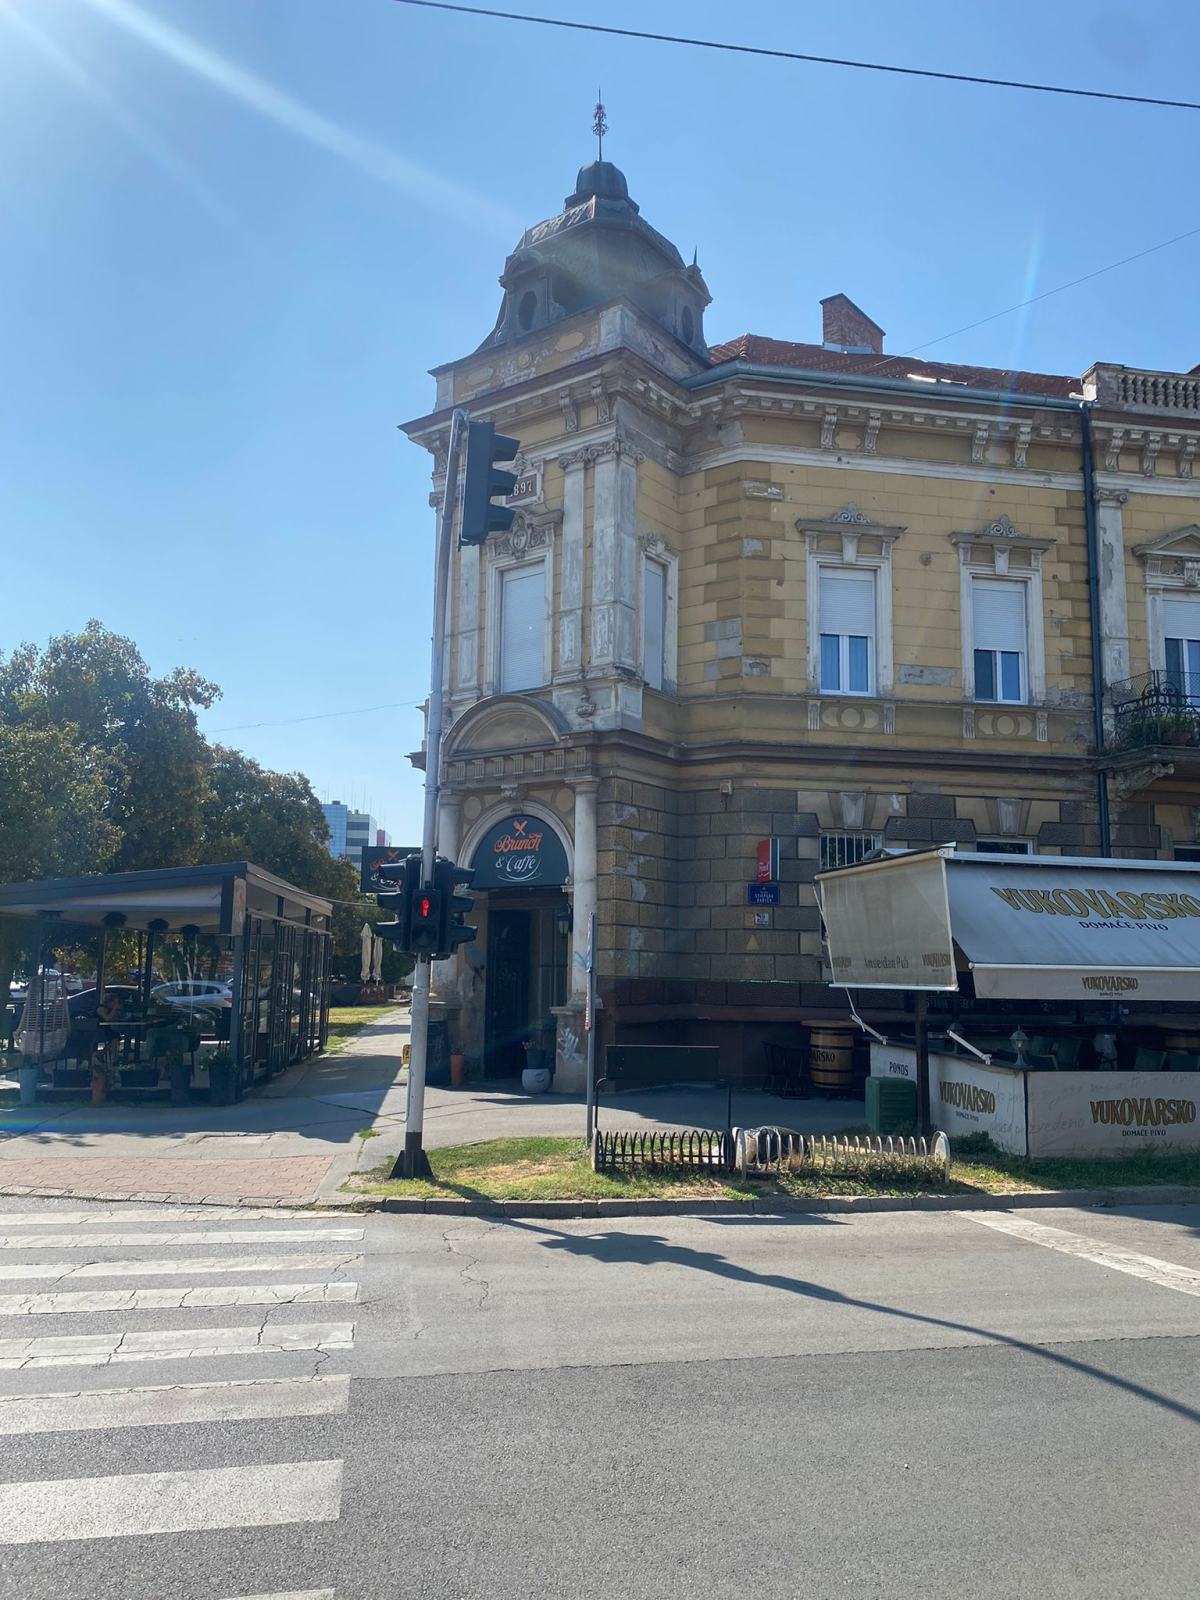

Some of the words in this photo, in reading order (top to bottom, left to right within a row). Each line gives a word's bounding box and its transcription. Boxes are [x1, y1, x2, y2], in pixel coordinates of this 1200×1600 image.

[511, 480, 532, 496] 897
[494, 832, 543, 853] Brunch
[495, 856, 504, 868] &
[1135, 922, 1170, 931] PIVO
[1081, 975, 1139, 991] VUKOVARSKO
[889, 1061, 909, 1076] PONOS
[939, 1081, 996, 1114] VUKOVARSKO
[1090, 1098, 1196, 1126] VUKOVARSKO
[1150, 1129, 1166, 1137] PIVO
